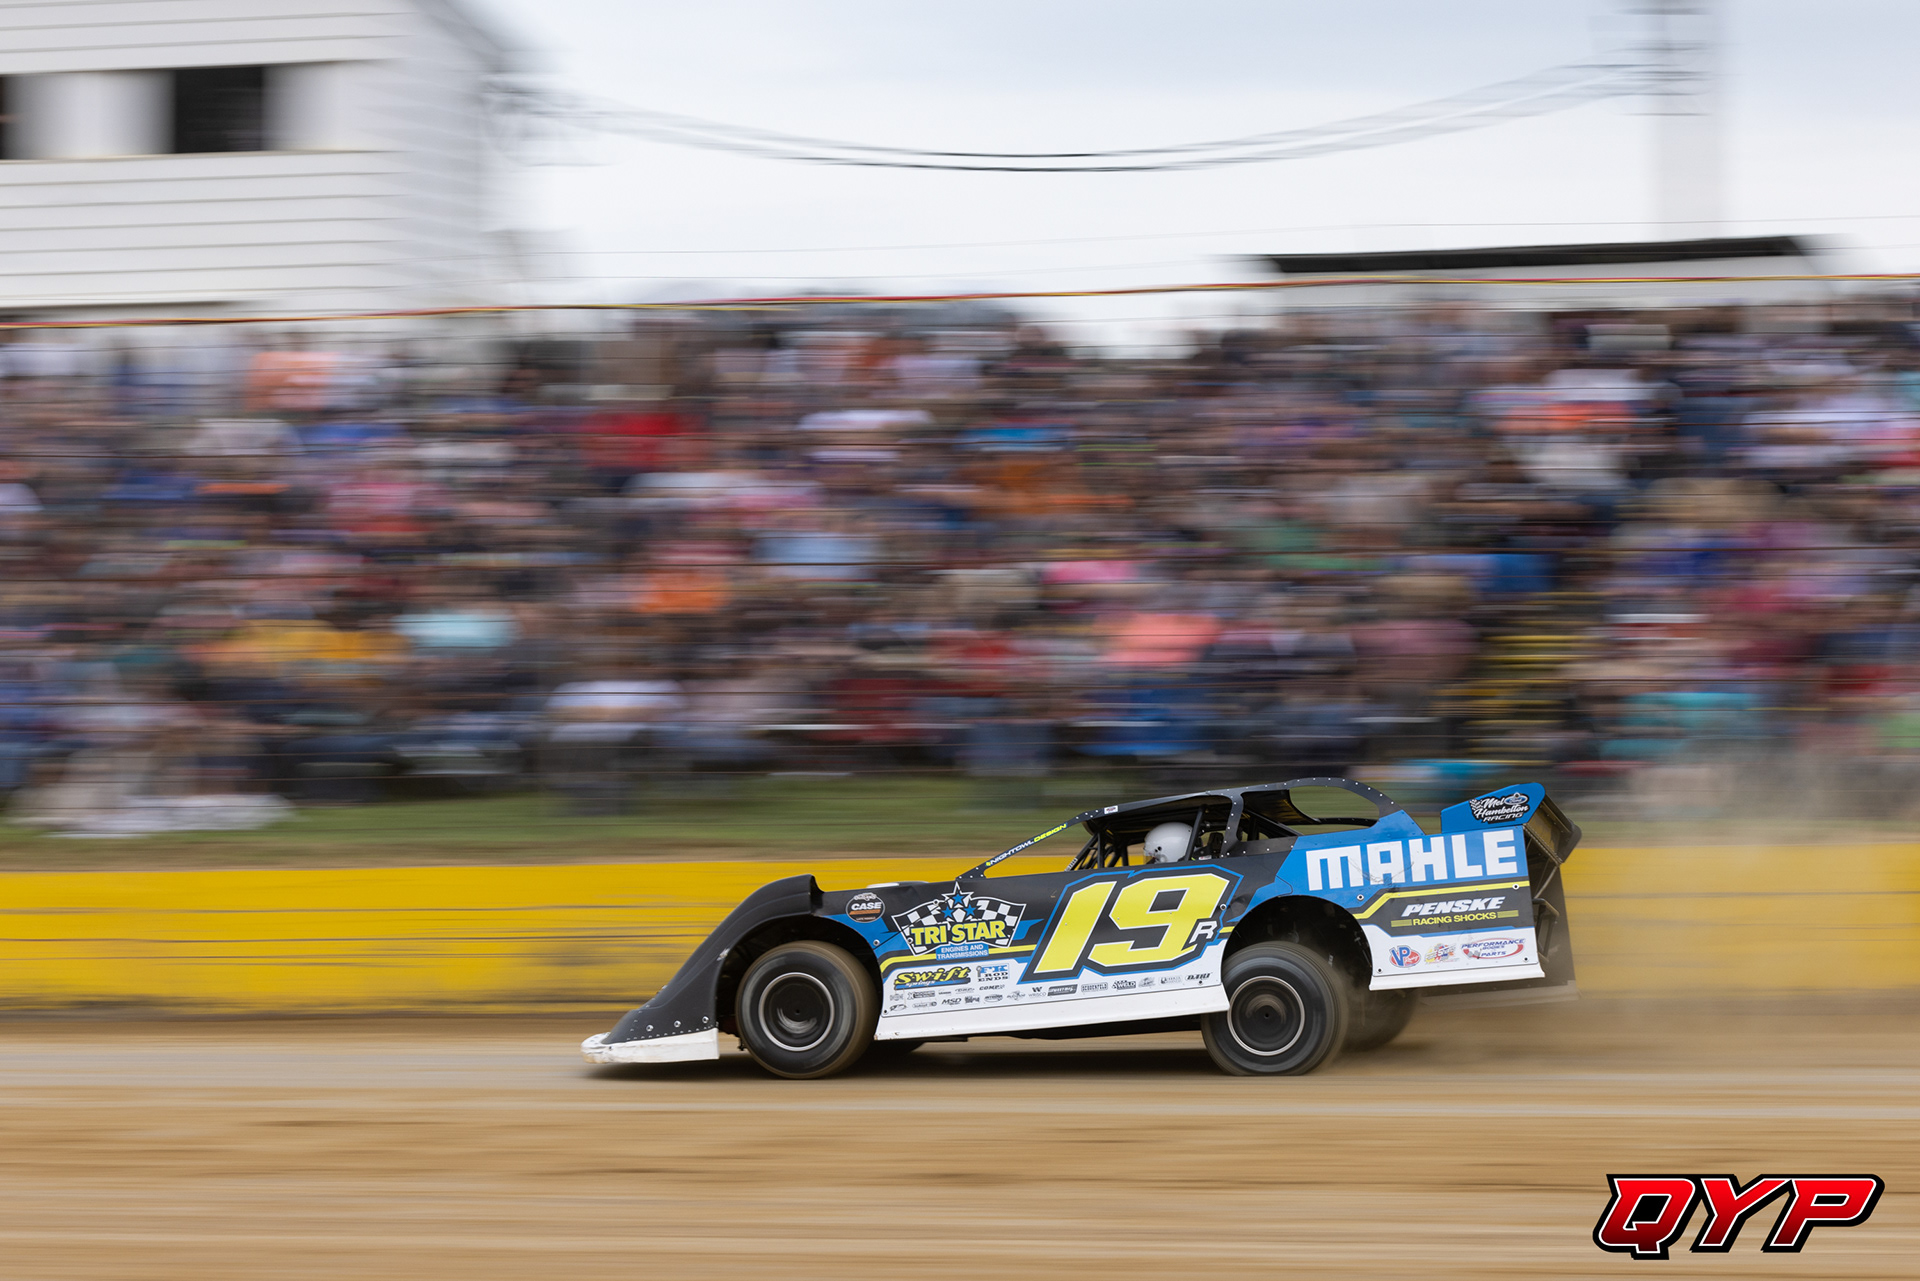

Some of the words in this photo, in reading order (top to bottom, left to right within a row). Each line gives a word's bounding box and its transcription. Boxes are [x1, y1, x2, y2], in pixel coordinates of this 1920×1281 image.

[1481, 797, 1505, 808] Mel
[1483, 812, 1523, 822] RACING
[1306, 829, 1518, 891] MAHLE
[851, 901, 882, 910] CASE
[1401, 896, 1506, 917] PENSKE
[1412, 916, 1452, 926] RACING
[1453, 912, 1497, 922] SHOCKS
[911, 926, 947, 946] TRI
[951, 920, 1006, 942] STAR
[941, 945, 968, 953] ENGINES
[1461, 938, 1525, 949] PERFORMANCE
[937, 949, 989, 959] TRANSMISSIONS
[1390, 945, 1411, 967] VP
[941, 997, 961, 1005] MSD
